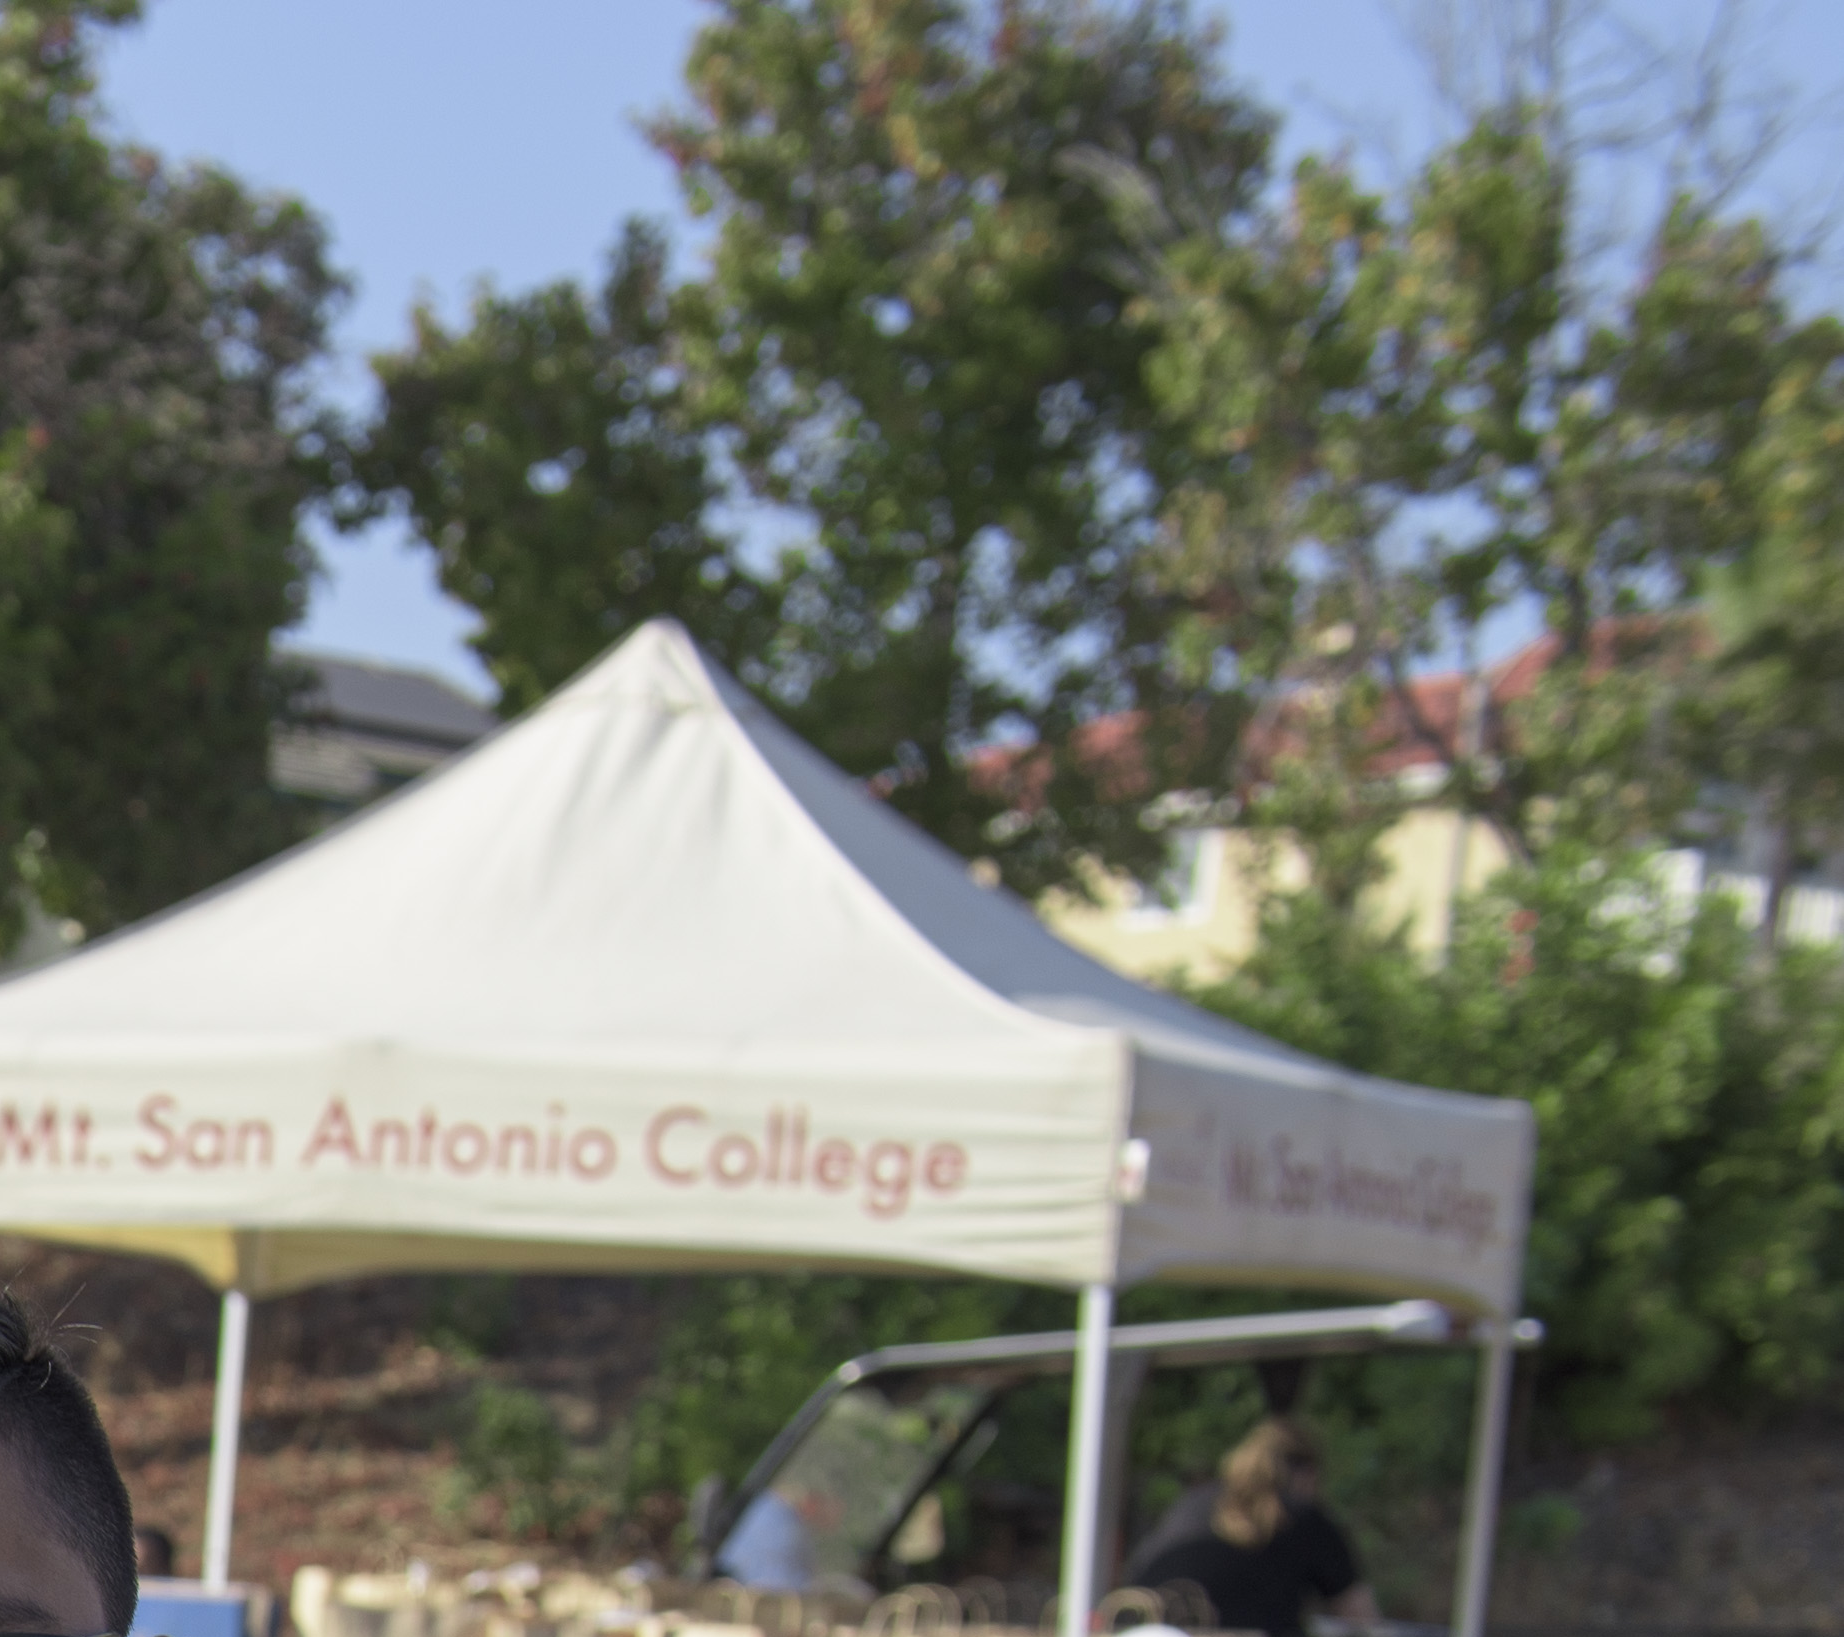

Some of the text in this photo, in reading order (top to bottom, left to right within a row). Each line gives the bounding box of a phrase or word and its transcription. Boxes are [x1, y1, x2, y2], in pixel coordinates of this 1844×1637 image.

[135, 1094, 274, 1171] San
[300, 1096, 618, 1184] Antonio
[643, 1103, 970, 1220] College
